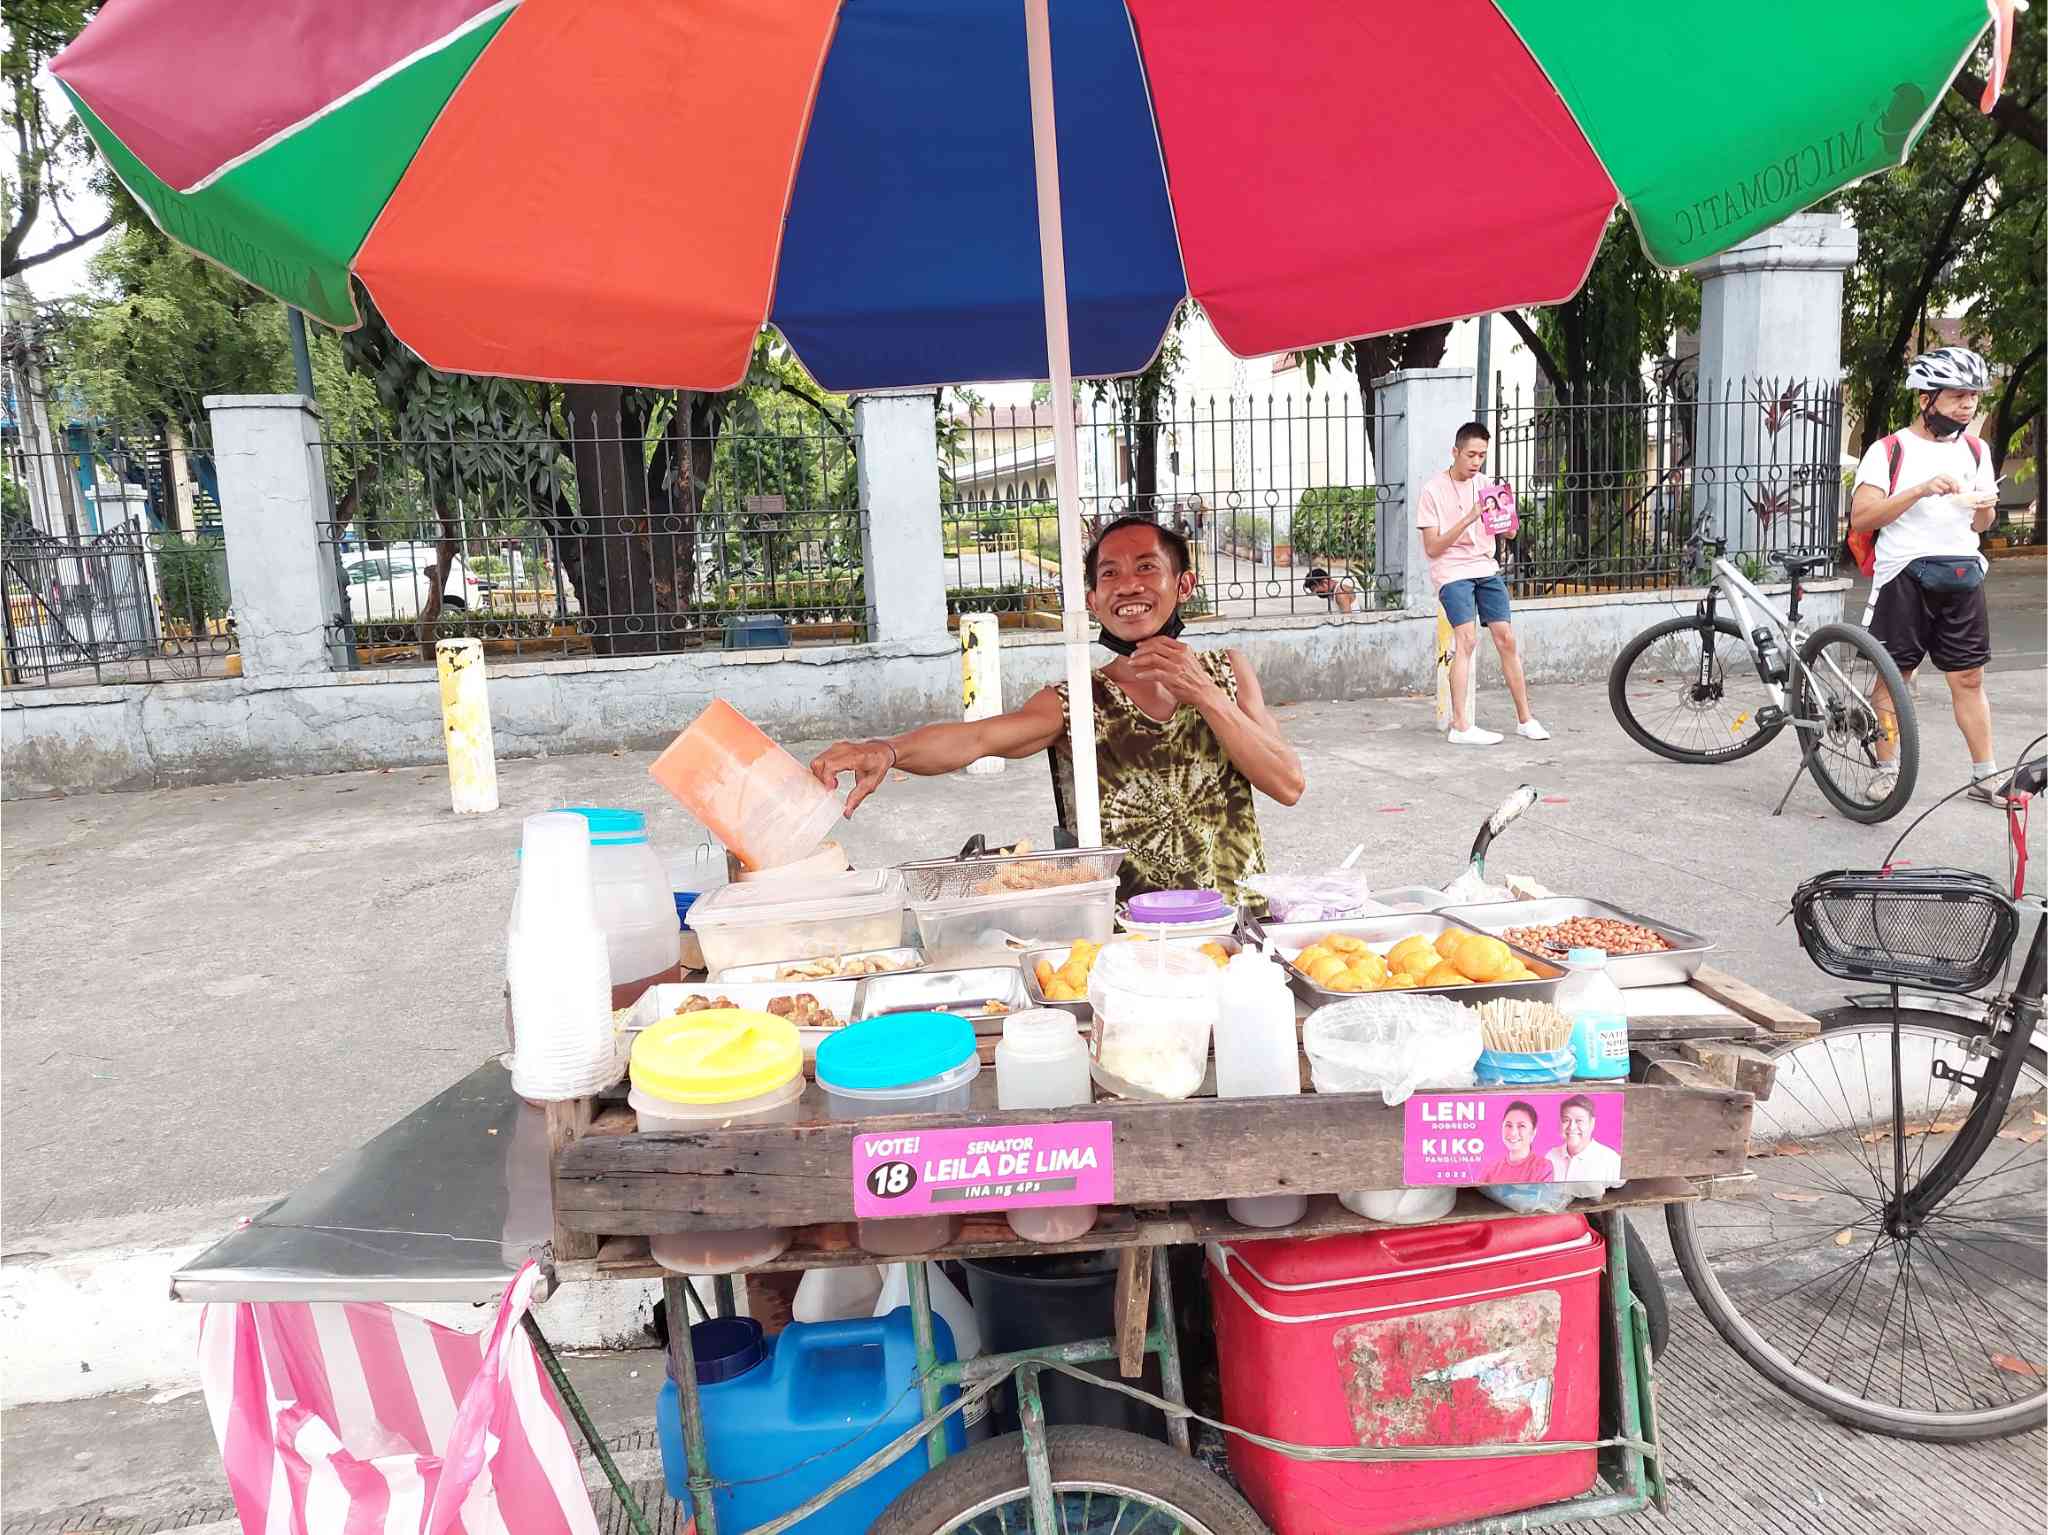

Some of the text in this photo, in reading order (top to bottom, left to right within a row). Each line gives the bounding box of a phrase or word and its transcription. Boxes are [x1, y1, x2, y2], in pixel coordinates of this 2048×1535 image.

[1422, 1101, 1485, 1121] LENI
[1431, 1122, 1477, 1130] ROBREDO
[865, 1136, 921, 1158] VOTE!
[967, 1137, 1034, 1155] SENATOR
[1422, 1138, 1485, 1155] KIKO
[923, 1147, 1098, 1183] LEILA DE LIMA
[1425, 1155, 1482, 1163] PANGILINAN
[874, 1163, 909, 1195] 18
[965, 1182, 1040, 1197] INA ng 4Ps
